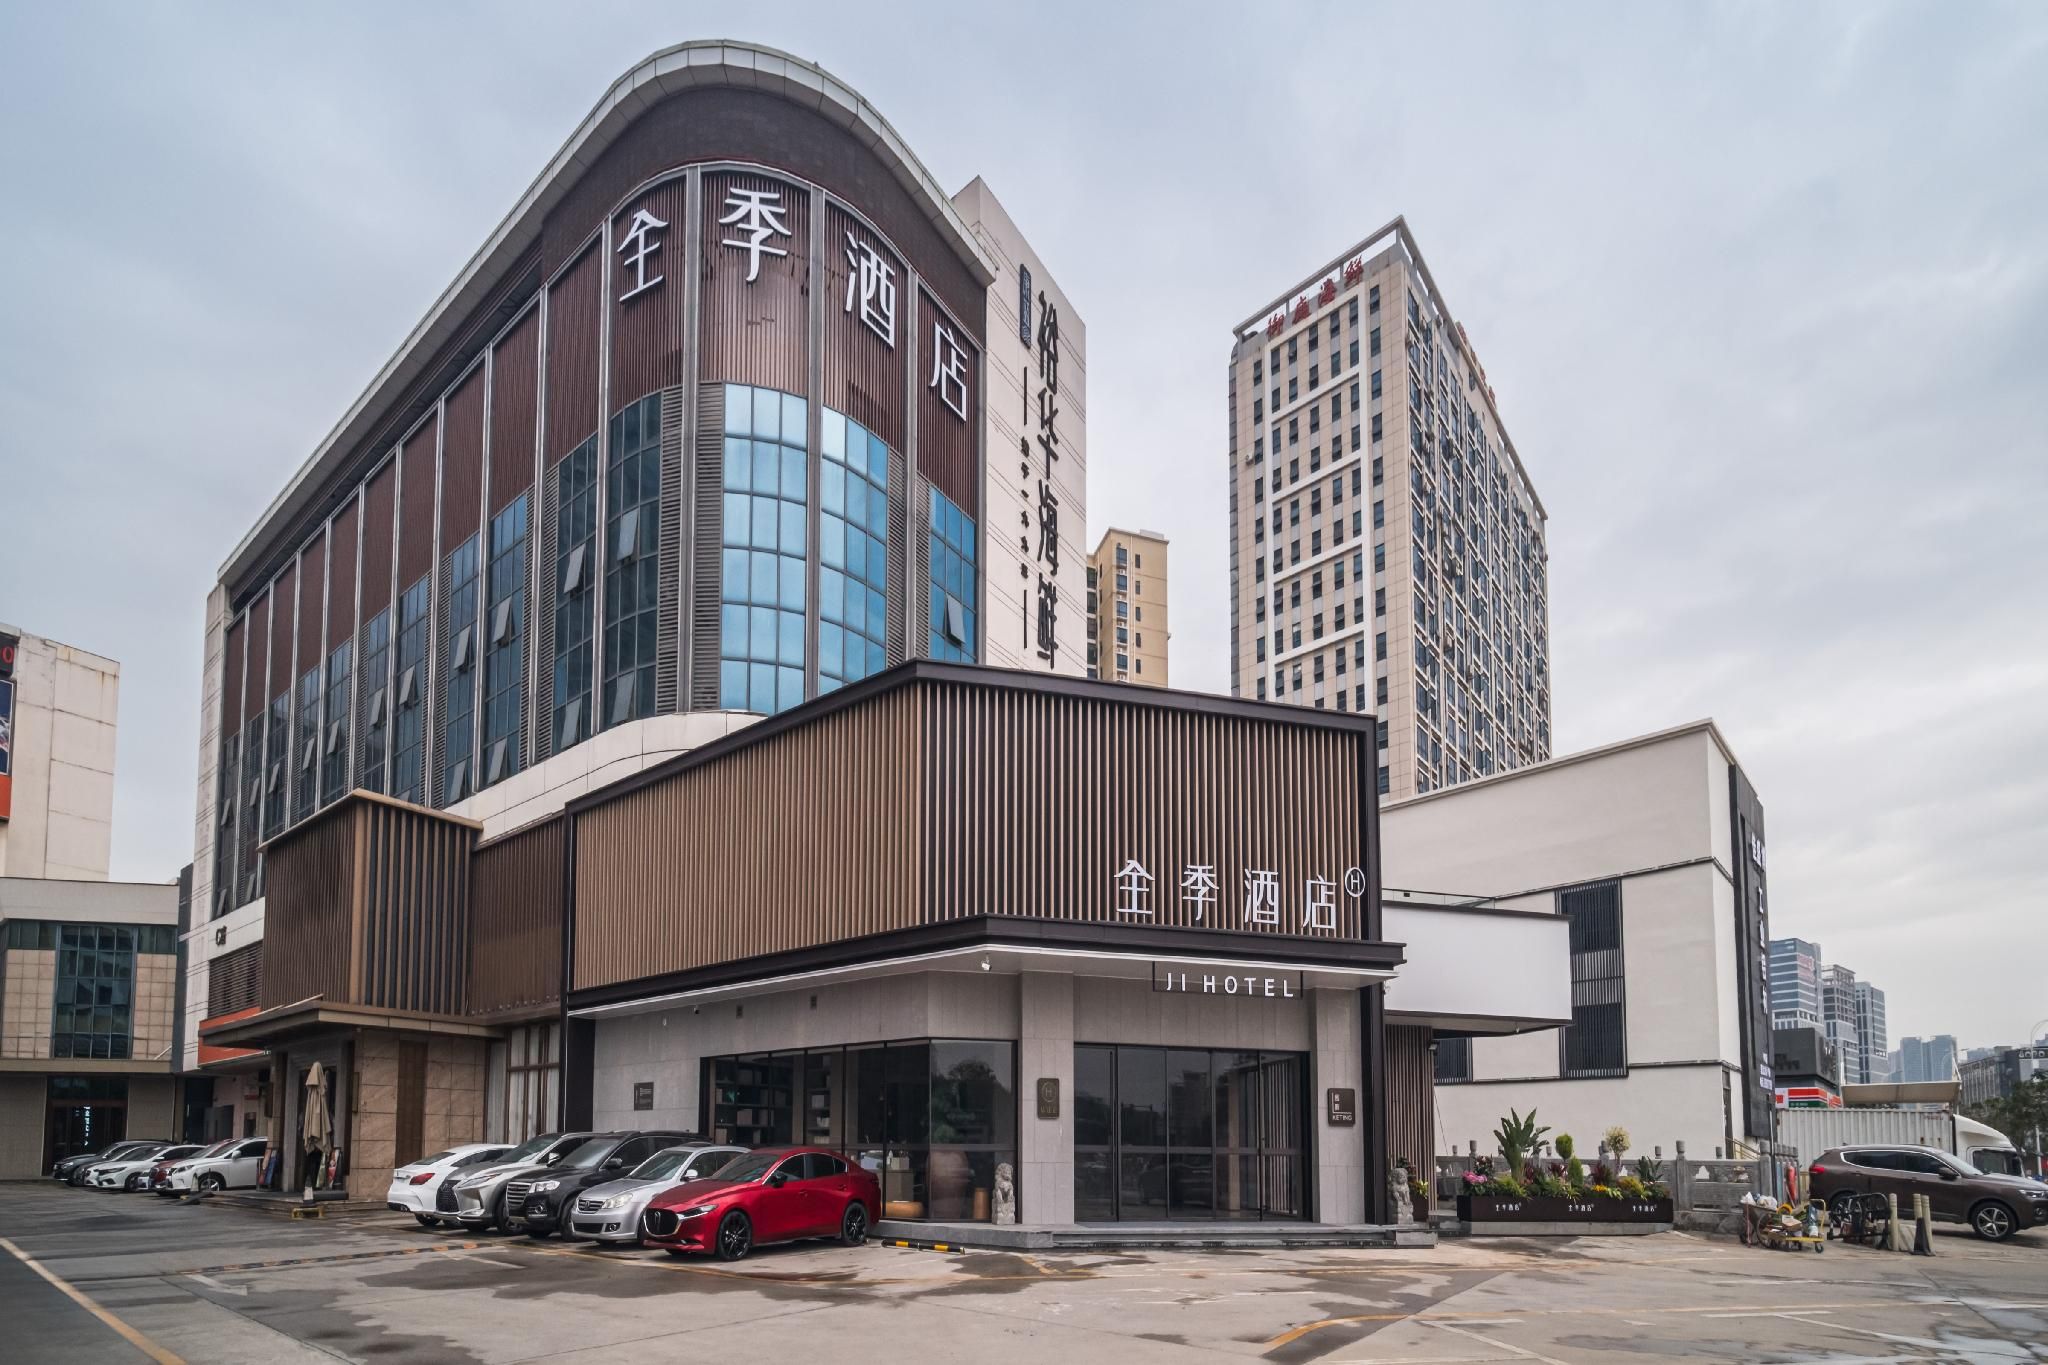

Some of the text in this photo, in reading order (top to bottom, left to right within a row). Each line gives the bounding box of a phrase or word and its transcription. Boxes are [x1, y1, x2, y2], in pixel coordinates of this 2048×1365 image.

[616, 187, 968, 421] 全季酒店
[1114, 859, 1337, 930] 全季酒店
[1166, 972, 1294, 998] JI HOTEL
